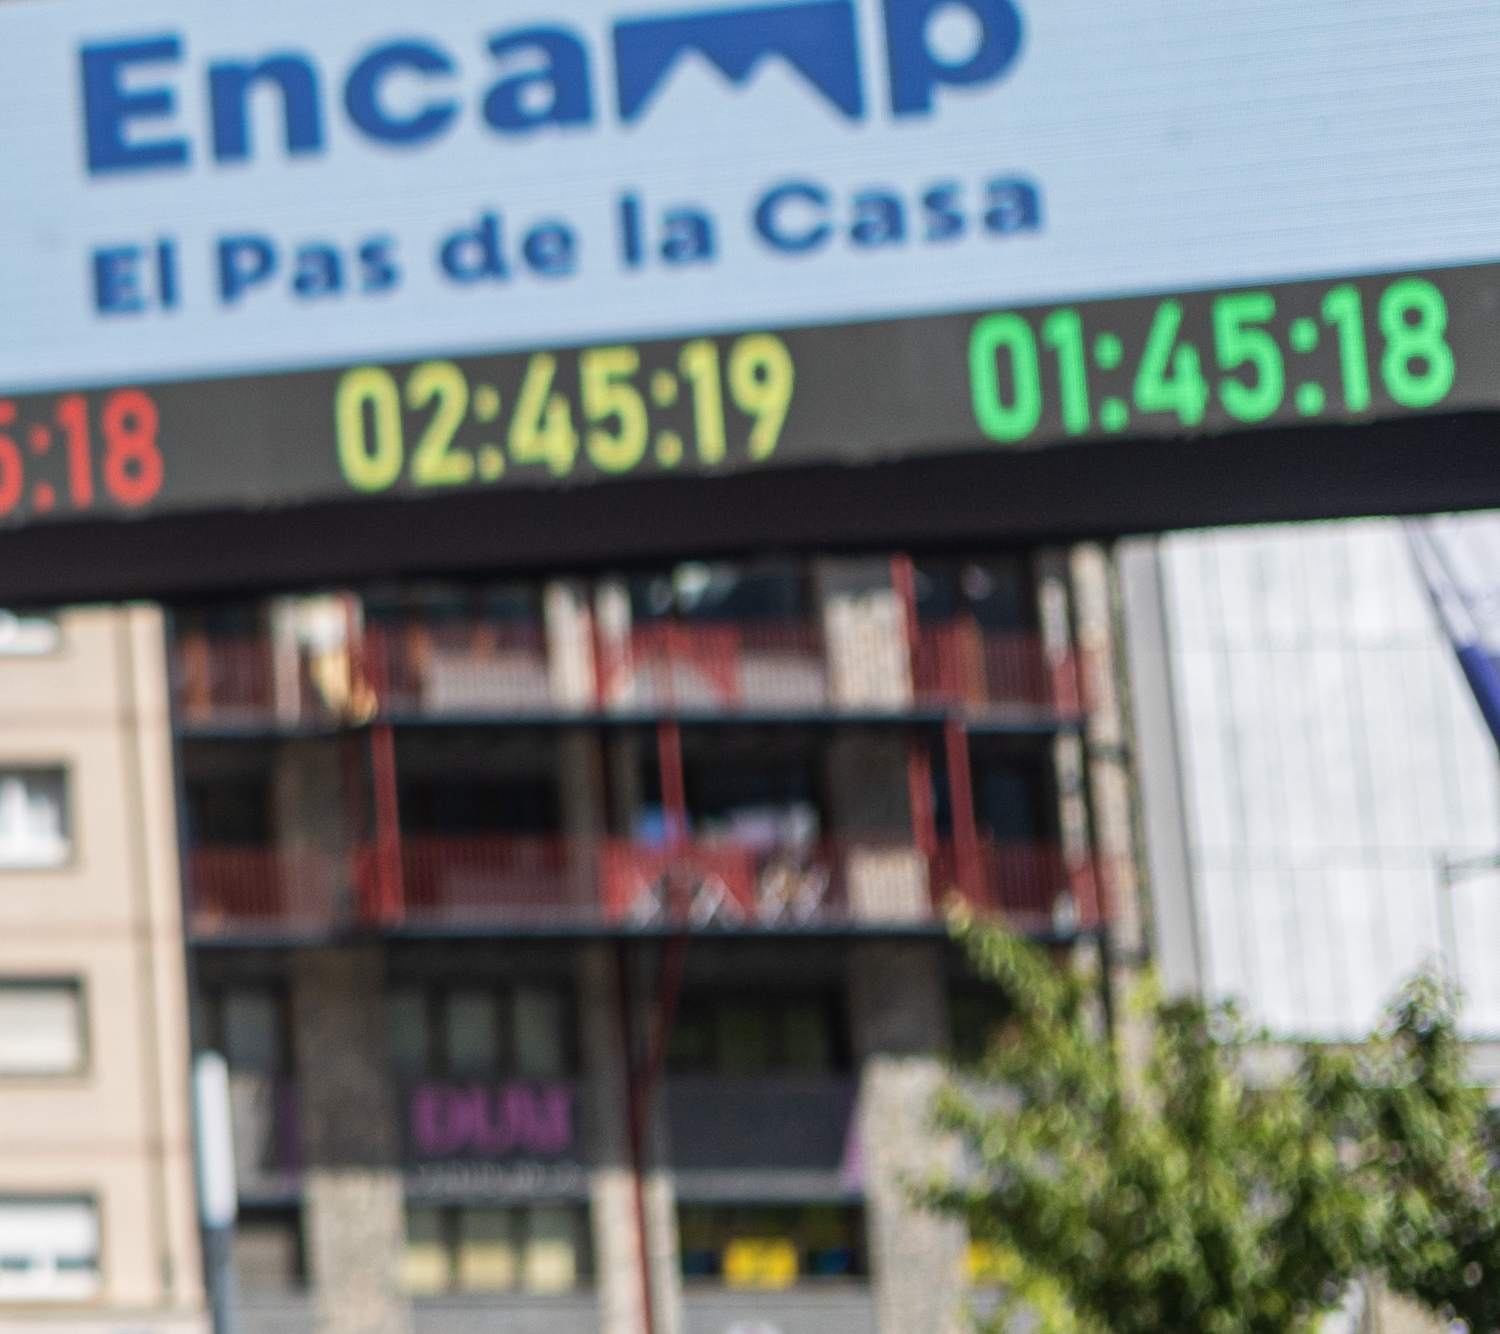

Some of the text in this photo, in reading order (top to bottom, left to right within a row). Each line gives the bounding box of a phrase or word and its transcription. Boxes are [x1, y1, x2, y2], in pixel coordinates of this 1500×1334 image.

[92, 172, 1042, 317] El Pas de la Casa
[336, 332, 795, 490] 02:45:19
[967, 277, 1457, 441] 01:45:18
